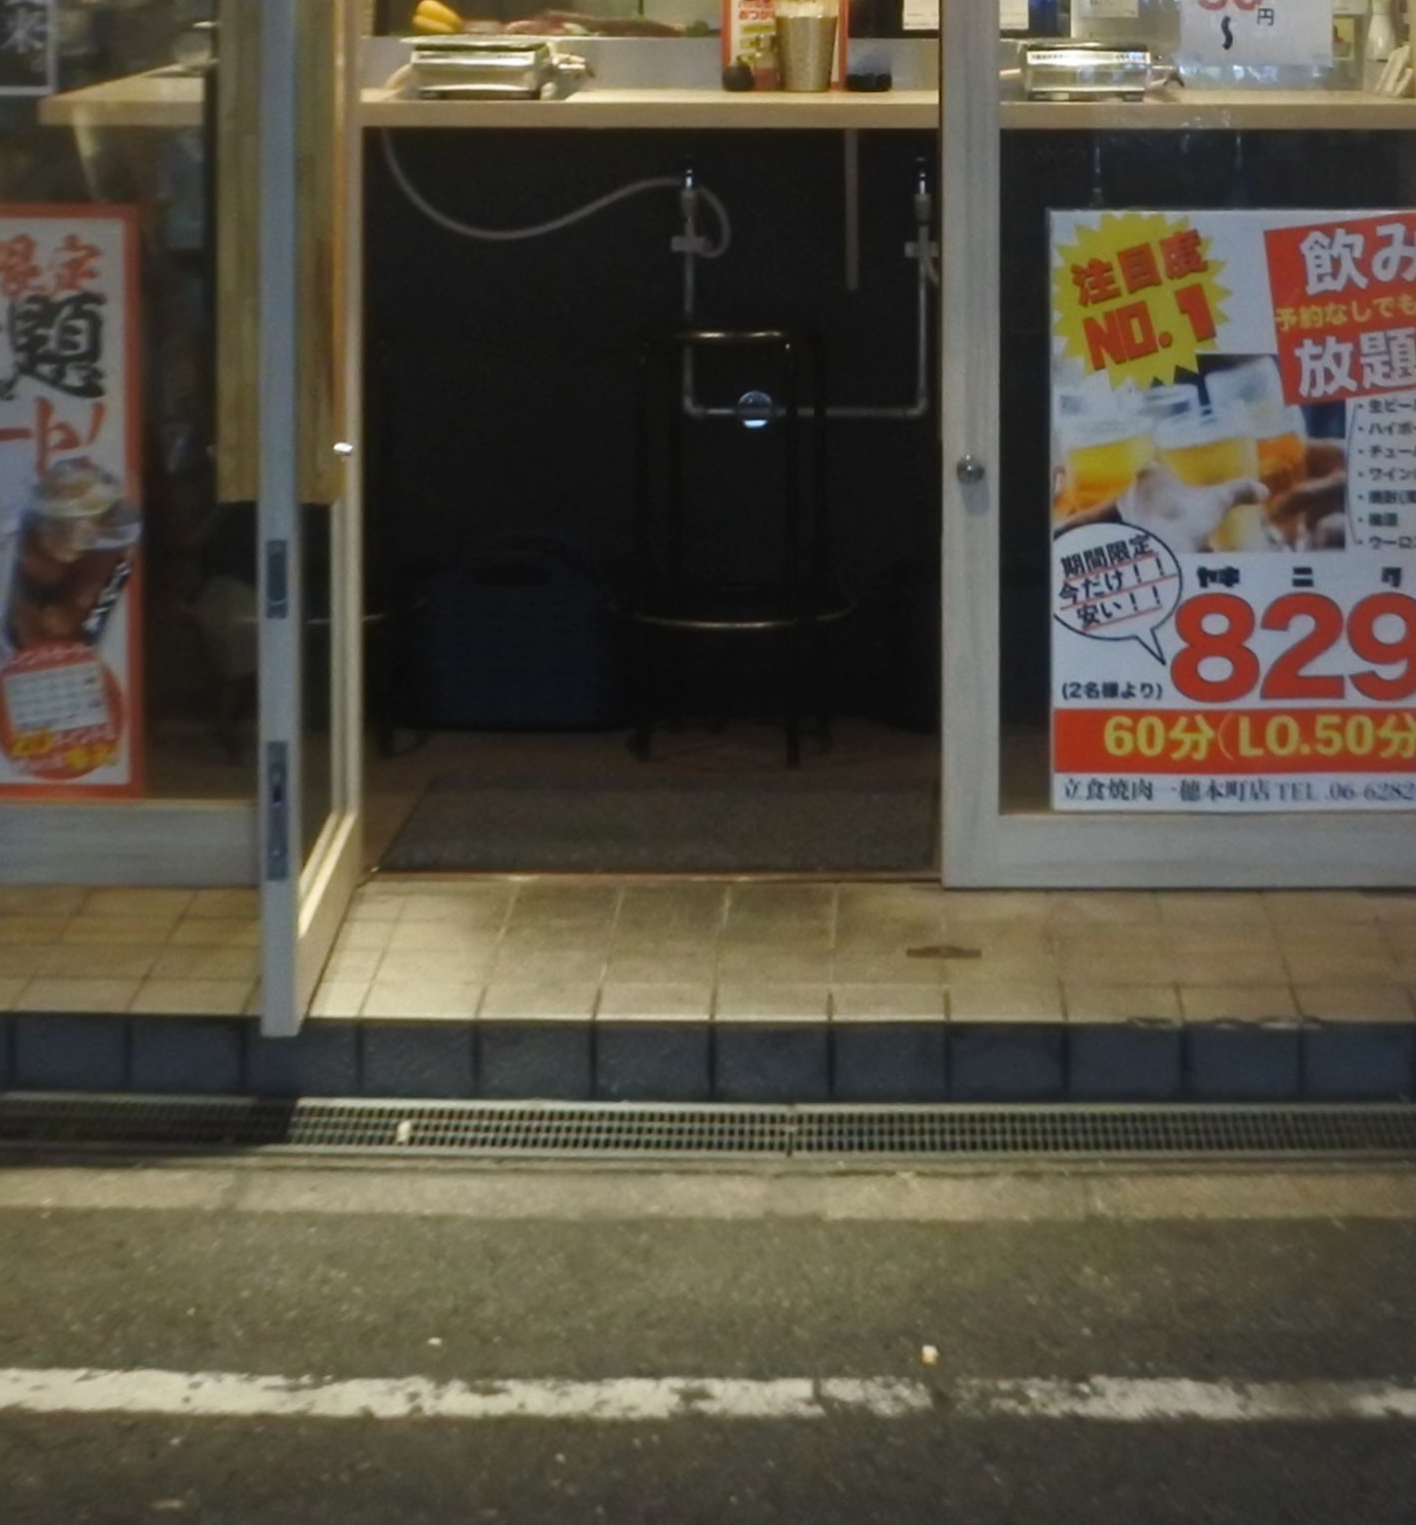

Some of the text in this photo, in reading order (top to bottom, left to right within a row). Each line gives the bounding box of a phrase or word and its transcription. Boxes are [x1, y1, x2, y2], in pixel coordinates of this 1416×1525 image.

[1071, 229, 1209, 307] 注目度
[1061, 533, 1150, 577] 期間限定
[1061, 682, 1163, 702] (2名様より)
